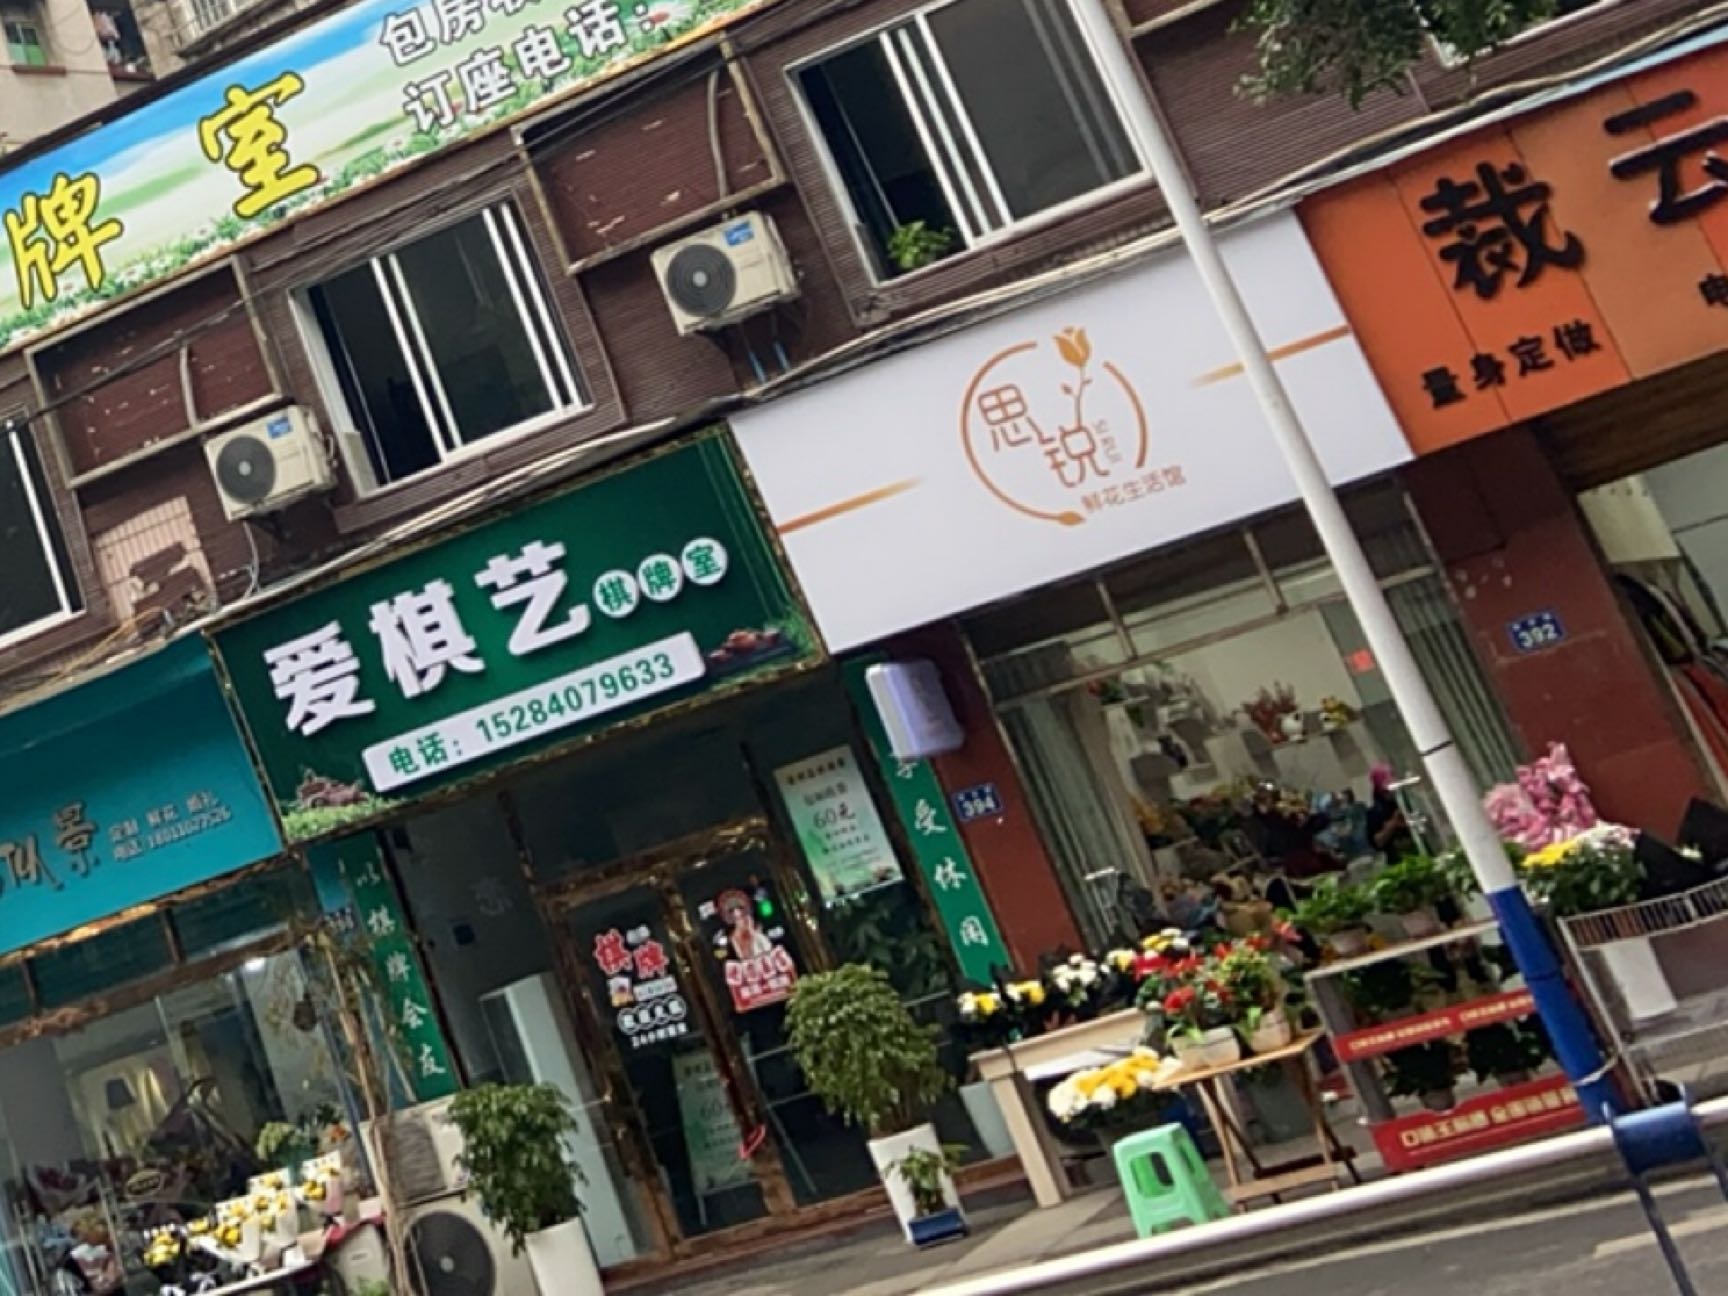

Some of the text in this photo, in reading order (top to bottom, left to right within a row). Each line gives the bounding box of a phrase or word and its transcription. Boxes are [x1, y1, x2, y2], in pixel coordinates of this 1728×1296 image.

[1421, 319, 1602, 410] 量身定做
[1080, 464, 1188, 513] 鲜花生活馆
[265, 539, 726, 738] 爱棋艺 棋牌室
[1518, 623, 1559, 648] 392
[388, 650, 677, 778] 电话：15284079633
